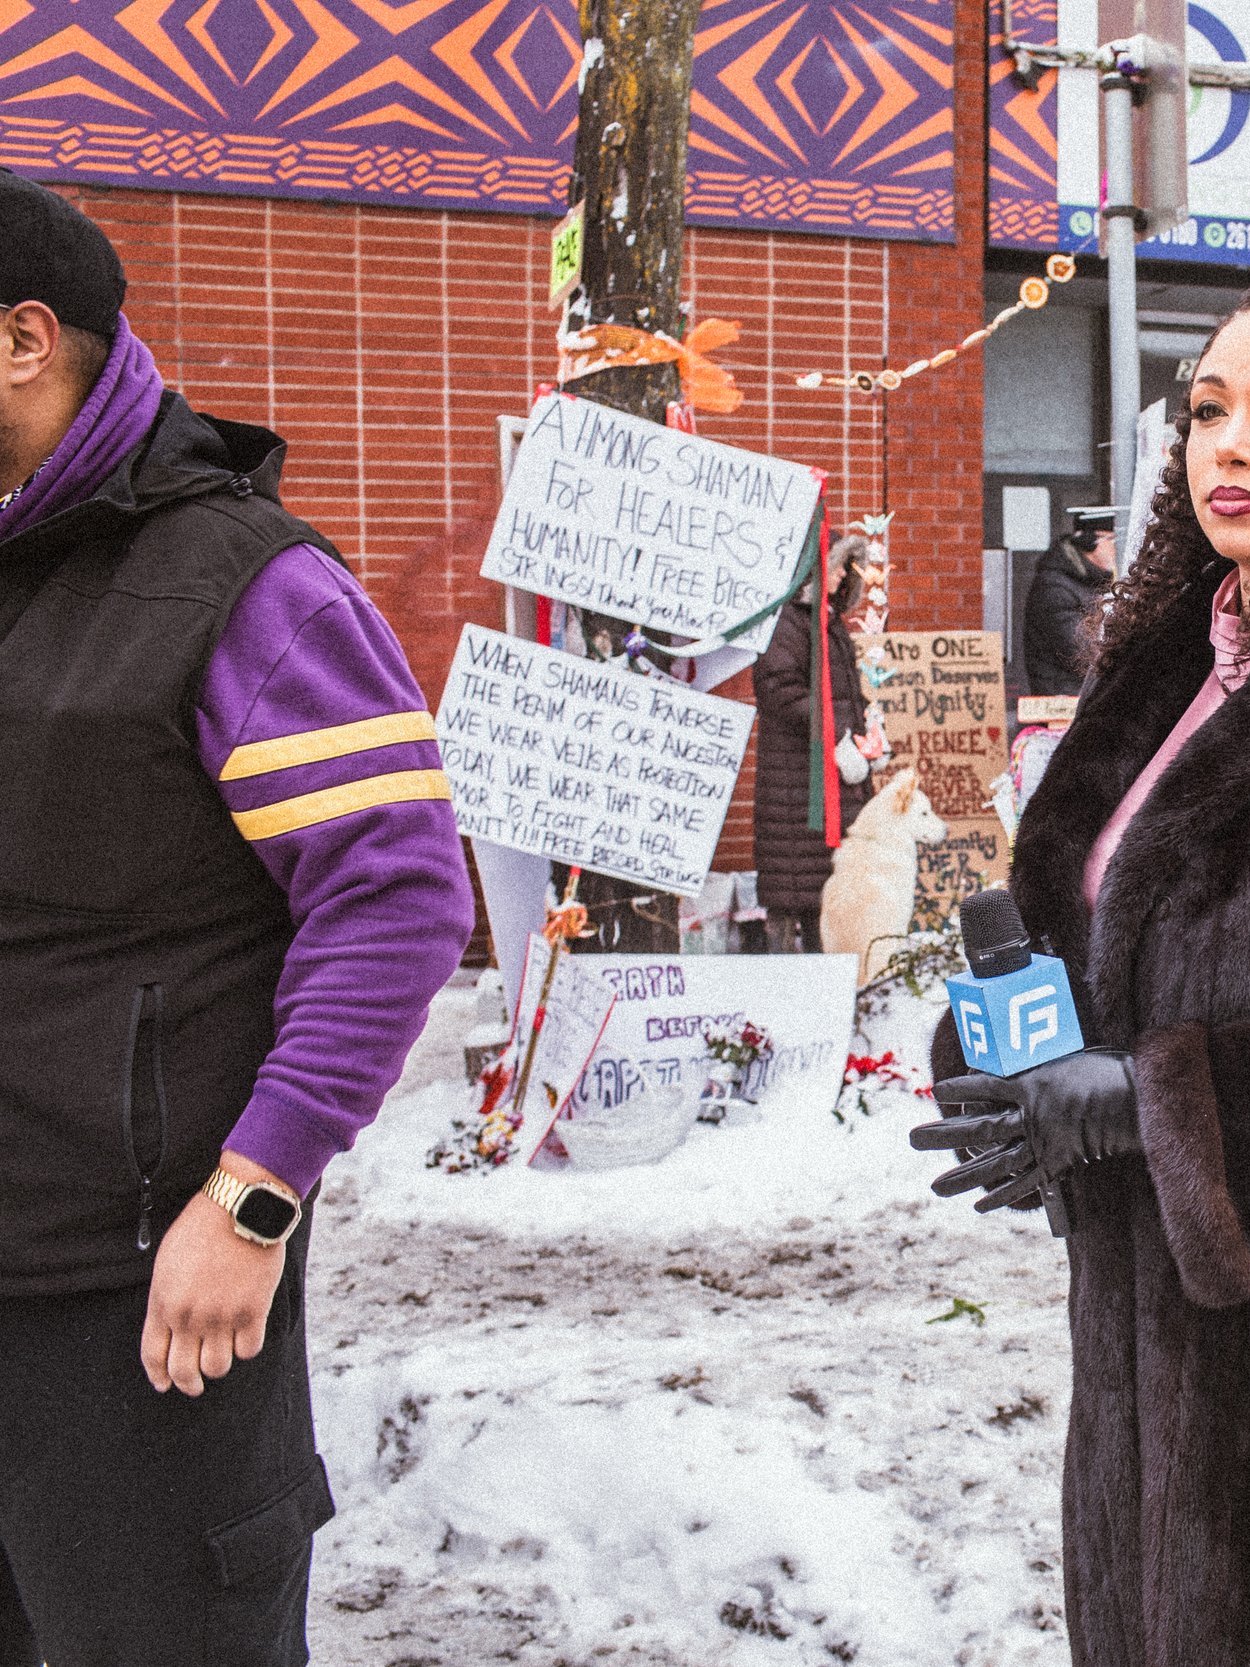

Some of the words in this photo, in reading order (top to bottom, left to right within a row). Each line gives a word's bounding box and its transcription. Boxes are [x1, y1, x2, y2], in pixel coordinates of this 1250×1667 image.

[532, 399, 565, 449] A
[667, 444, 794, 512] SHAMAN
[546, 460, 596, 514] FOR
[615, 481, 763, 569] HEALERS
[509, 509, 642, 583] HUMANITY!
[650, 554, 706, 598] FREE
[461, 673, 500, 706] THE
[574, 711, 602, 733] OF
[611, 720, 656, 751] OUR
[468, 635, 533, 680] WHEN
[545, 661, 640, 712] SHAMANS
[649, 688, 734, 740] TRAVERSE
[445, 708, 481, 736] WE
[488, 718, 544, 752] WEAR
[605, 752, 632, 780] AS
[917, 728, 987, 757] RENEE
[507, 757, 541, 790] WE
[549, 772, 597, 802] WEAR
[604, 784, 643, 817] THAT
[649, 799, 706, 832] SAME
[531, 800, 589, 835] FIGHT
[639, 828, 685, 861] HEAL
[602, 965, 686, 1001] EATH
